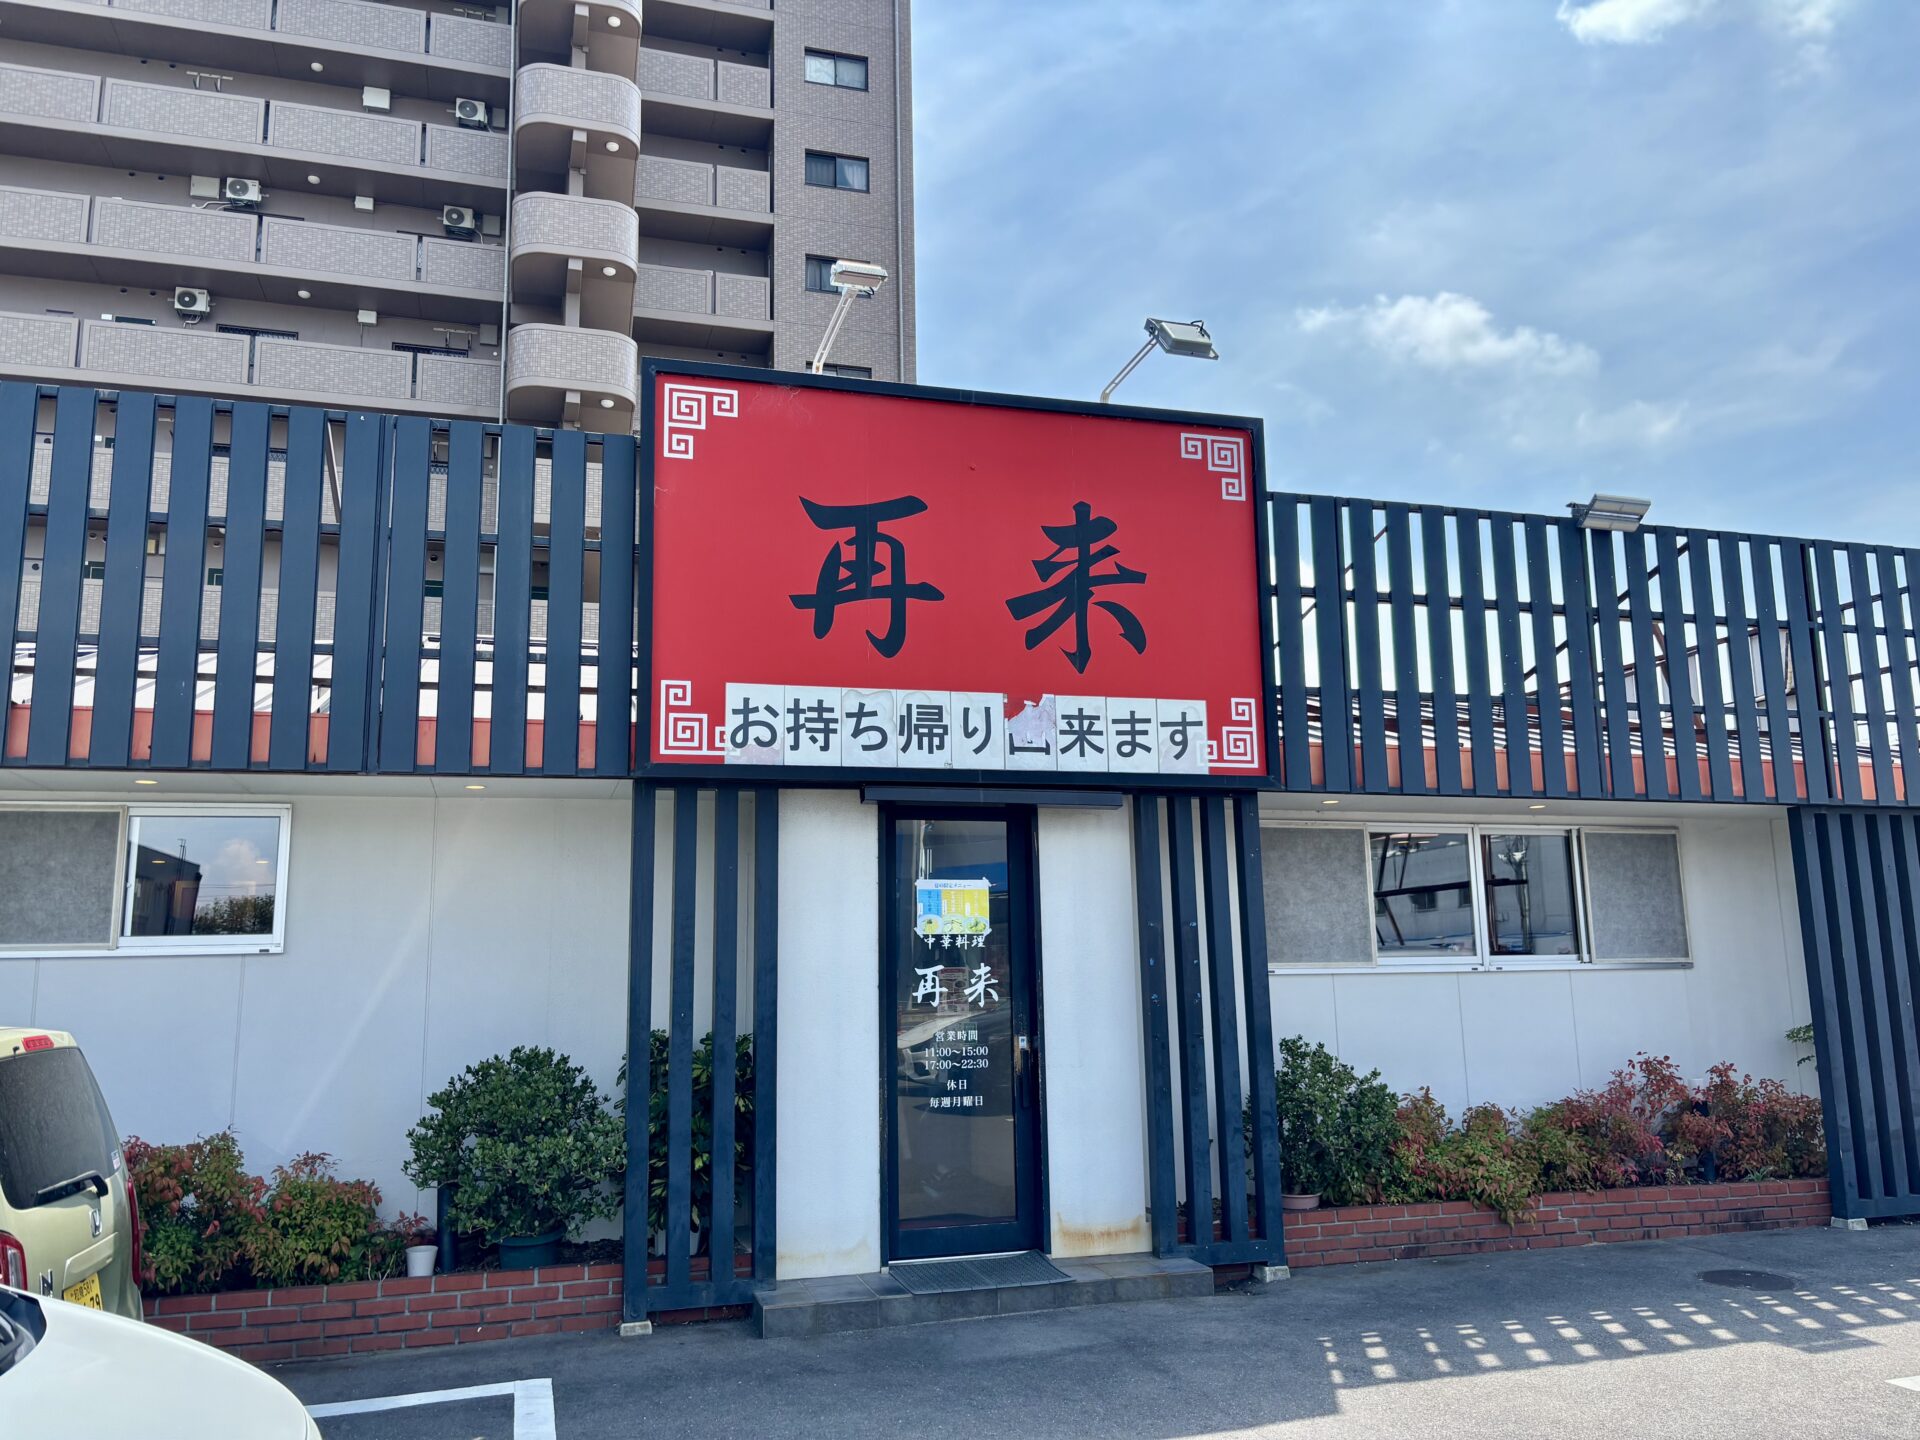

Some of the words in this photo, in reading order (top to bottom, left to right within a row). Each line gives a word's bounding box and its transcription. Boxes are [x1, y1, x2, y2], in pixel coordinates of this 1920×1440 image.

[789, 495, 1148, 674] 再来
[924, 934, 986, 950] 中華料理
[912, 962, 999, 1008] 再来
[935, 1030, 978, 1042] 営業時間
[947, 1079, 968, 1091] 休日
[929, 1095, 983, 1108] 毎週月曜日
